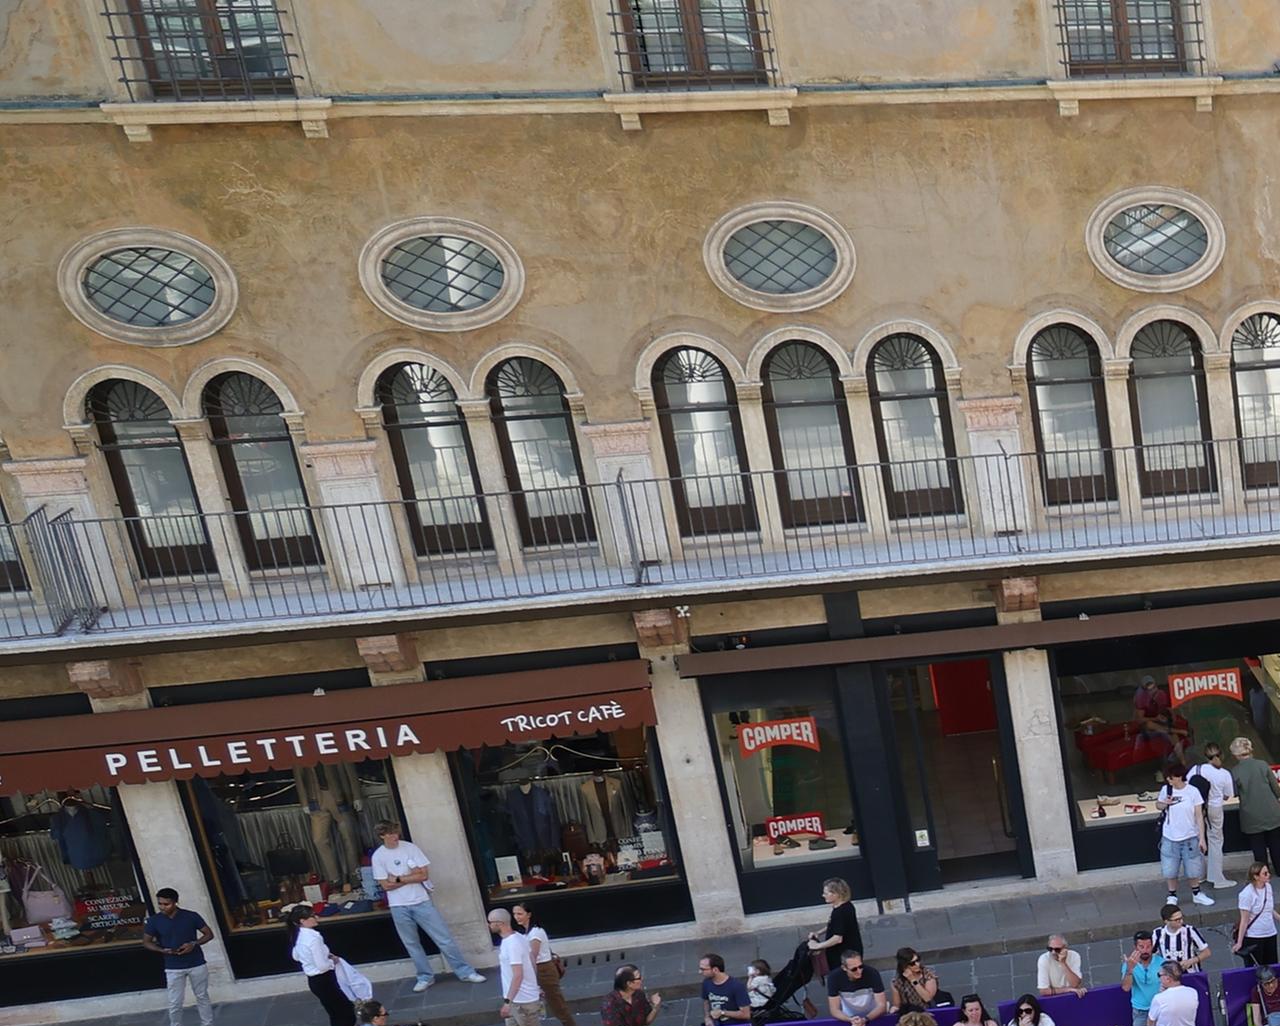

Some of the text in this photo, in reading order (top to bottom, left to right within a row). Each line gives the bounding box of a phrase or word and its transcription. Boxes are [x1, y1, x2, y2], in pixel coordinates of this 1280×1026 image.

[1173, 671, 1239, 701] CAMPER
[500, 701, 626, 733] TRICOT CAFÈ
[105, 723, 421, 777] PELLETTERIA
[741, 721, 815, 751] CAMPER
[768, 816, 823, 840] CAMPER
[84, 894, 135, 907] CONFEZIONI
[99, 901, 131, 912] MISURA
